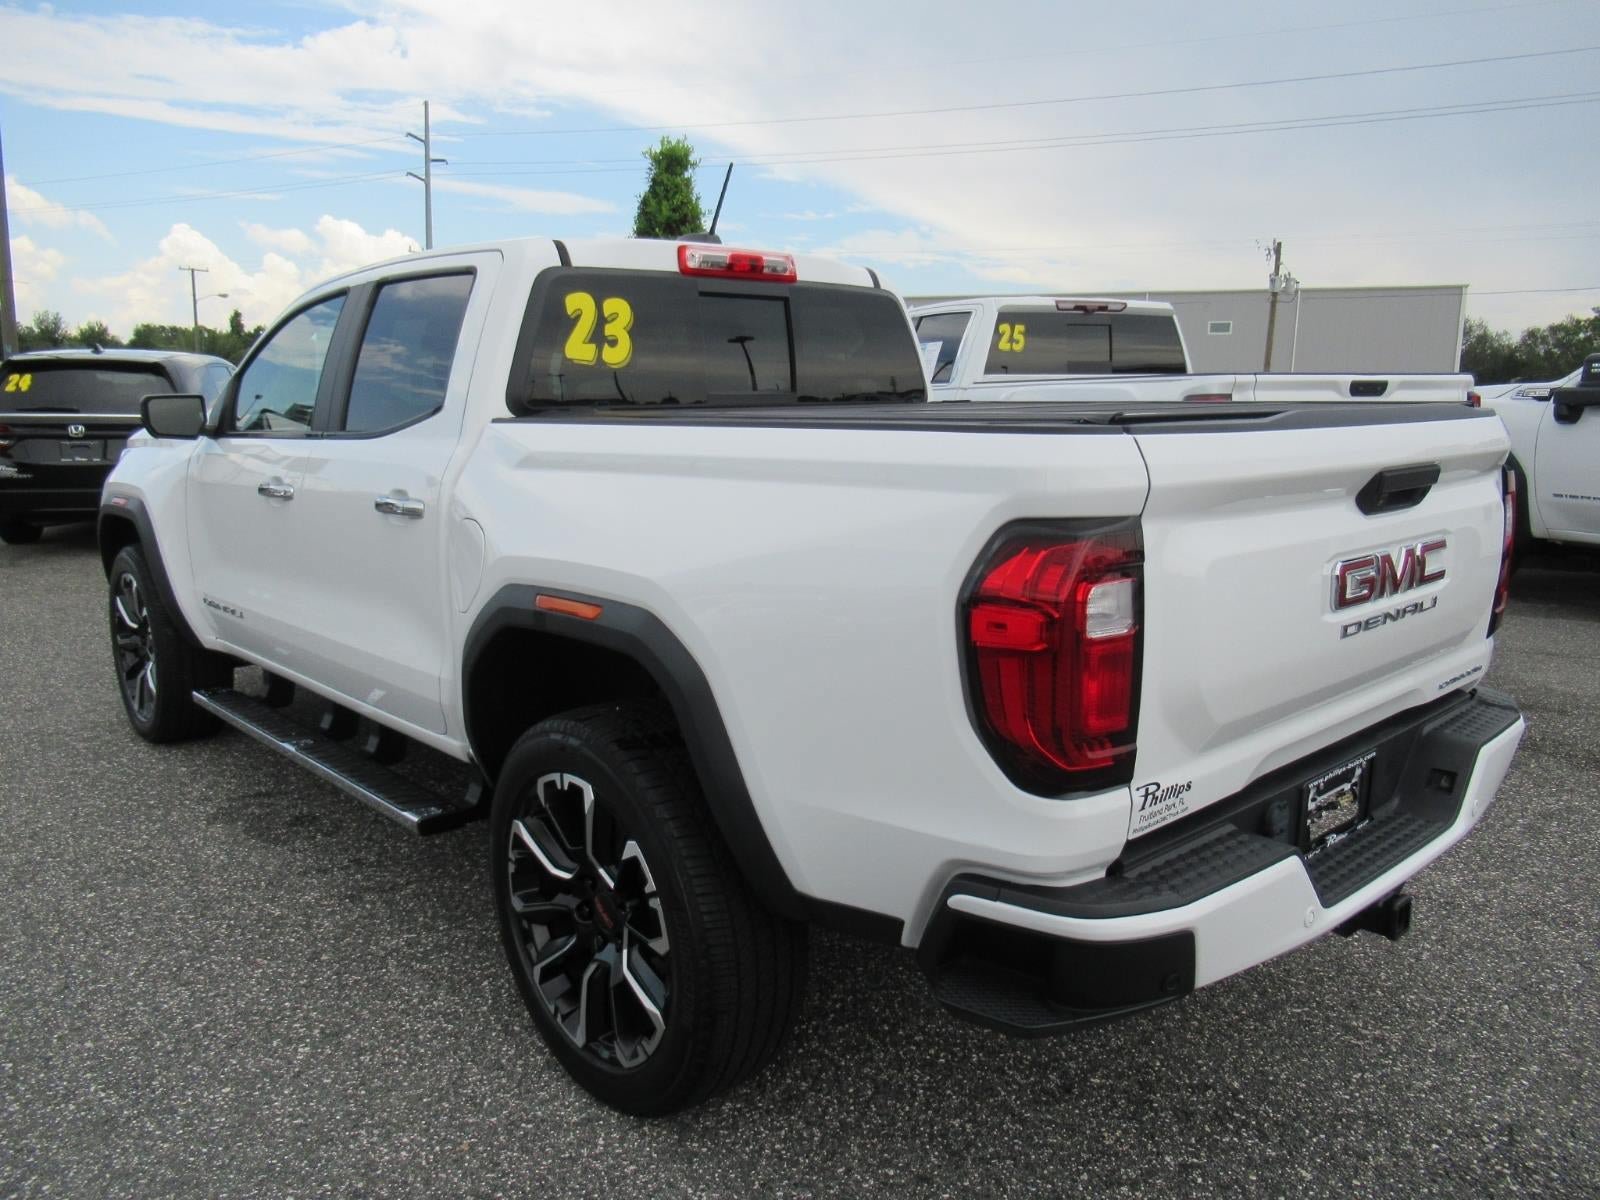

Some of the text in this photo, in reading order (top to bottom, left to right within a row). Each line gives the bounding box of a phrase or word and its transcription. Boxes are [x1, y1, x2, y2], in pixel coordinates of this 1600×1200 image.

[564, 292, 634, 369] 23
[998, 323, 1025, 352] 25
[4, 373, 33, 392] 24
[1330, 536, 1448, 613] GMC
[1340, 596, 1438, 640] DENALI
[1136, 781, 1192, 812] Phillips
